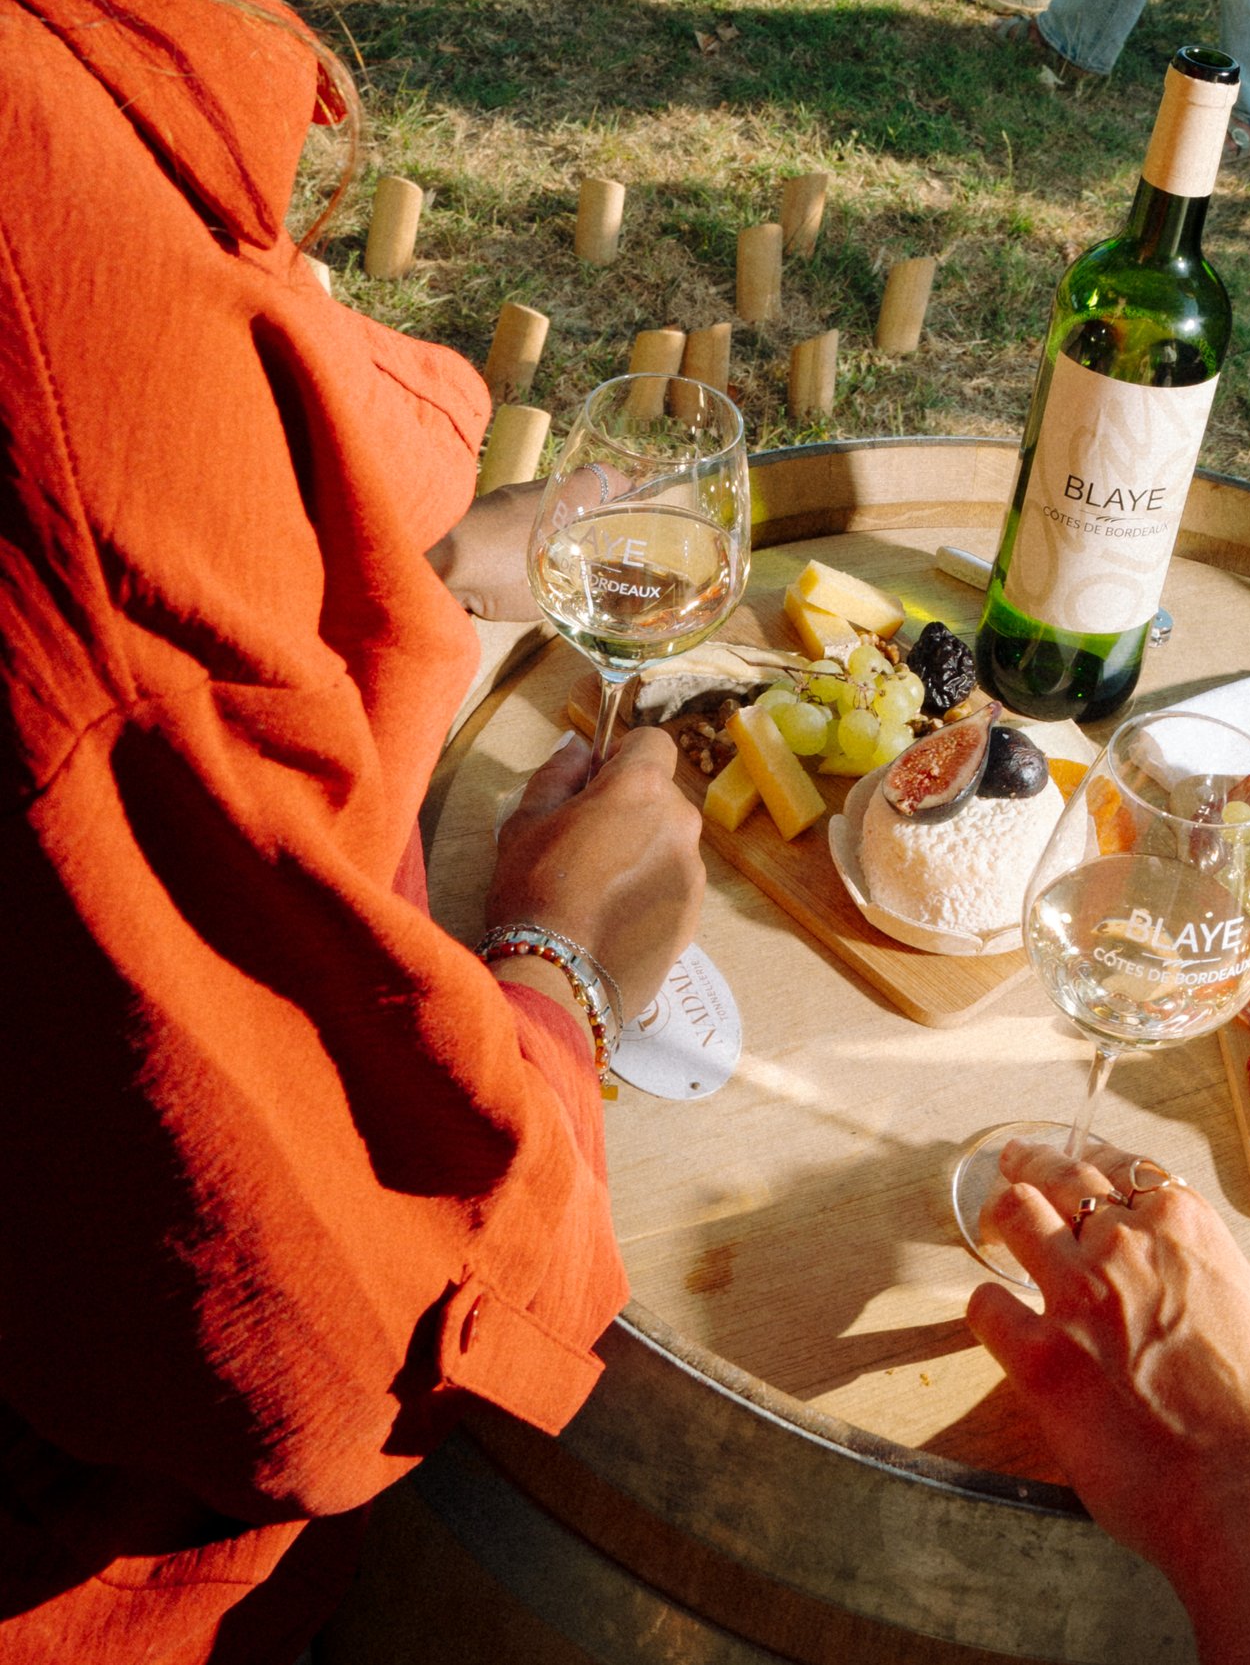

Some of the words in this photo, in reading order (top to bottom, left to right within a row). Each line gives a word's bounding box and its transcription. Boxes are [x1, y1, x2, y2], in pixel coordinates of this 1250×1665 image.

[1064, 474, 1166, 512] BLAYE
[1043, 505, 1081, 530] CÔTES
[1083, 522, 1102, 535] DE
[1105, 522, 1169, 538] BORDEAUX
[582, 571, 661, 598] ORDEAUX
[1124, 908, 1245, 953] BLAYE
[1093, 947, 1145, 978] CÔTES
[1147, 968, 1171, 983] DE
[691, 959, 728, 1023] TONNELLERIE
